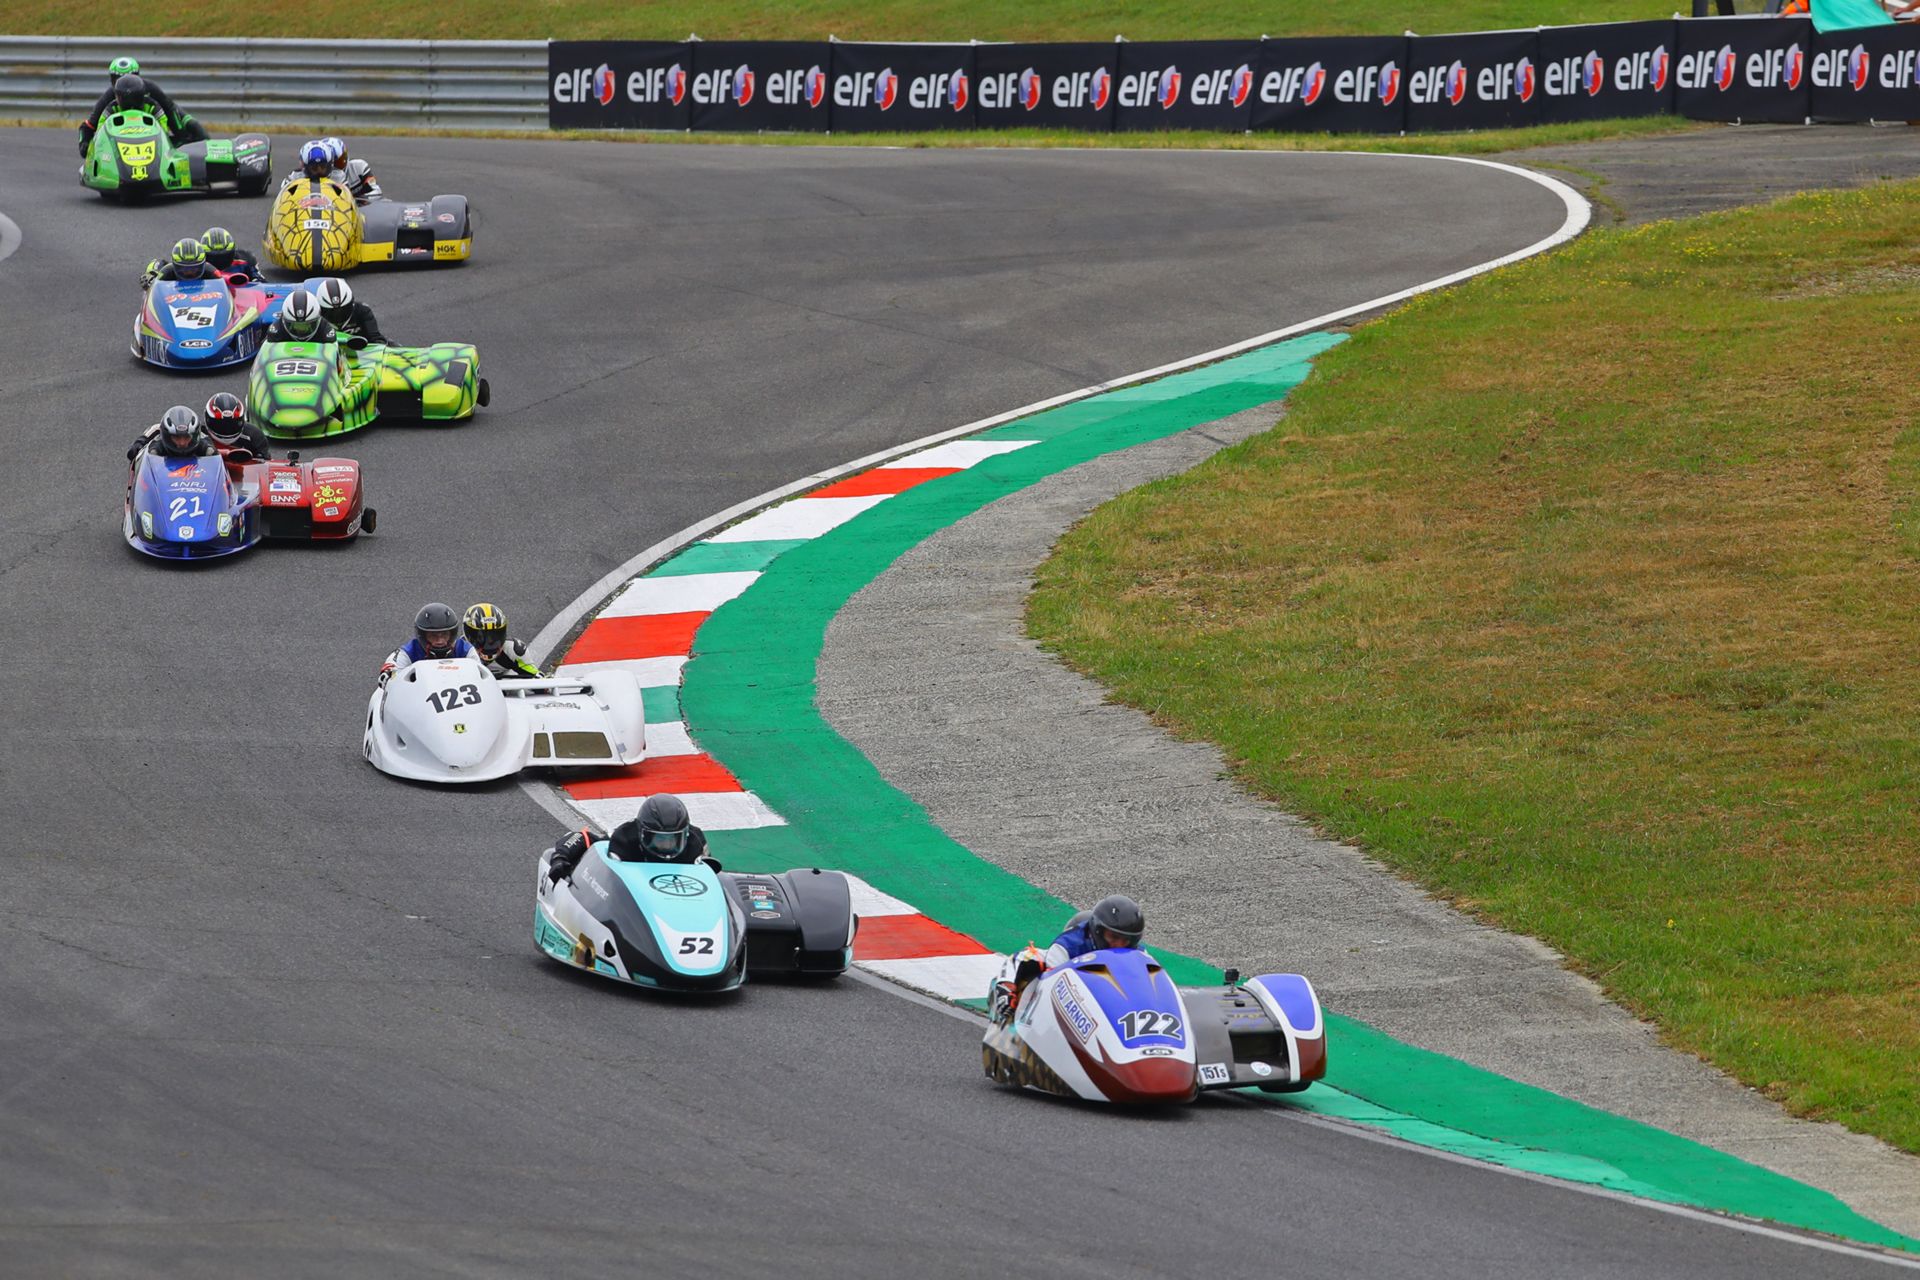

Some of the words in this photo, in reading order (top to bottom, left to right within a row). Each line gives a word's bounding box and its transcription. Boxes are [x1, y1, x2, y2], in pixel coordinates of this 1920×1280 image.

[554, 68, 592, 102] elf
[627, 68, 664, 102] elf
[692, 69, 732, 103] elf
[1260, 67, 1303, 103] elf
[1334, 66, 1377, 102] elf
[1408, 66, 1446, 103] elf
[1477, 63, 1513, 100] elf
[1545, 57, 1581, 95] elf
[1614, 52, 1650, 90] elf
[1676, 52, 1716, 88] elf
[1745, 52, 1783, 87] elf
[1811, 52, 1848, 87] elf
[1879, 52, 1915, 88] elf
[766, 70, 804, 104] elf
[834, 72, 875, 106] elf
[909, 74, 948, 108] elf
[979, 73, 1017, 107] elf
[1053, 72, 1090, 107] elf
[1118, 71, 1159, 106] elf
[1191, 69, 1232, 105] elf
[122, 146, 153, 156] 214
[305, 221, 328, 229] 156
[437, 245, 456, 253] NGK
[276, 361, 317, 376] 99
[169, 496, 205, 522] 21
[426, 684, 482, 713] 123
[679, 937, 714, 955] 52
[1064, 1001, 1091, 1036] ARNOS
[1118, 1010, 1182, 1040] 122
